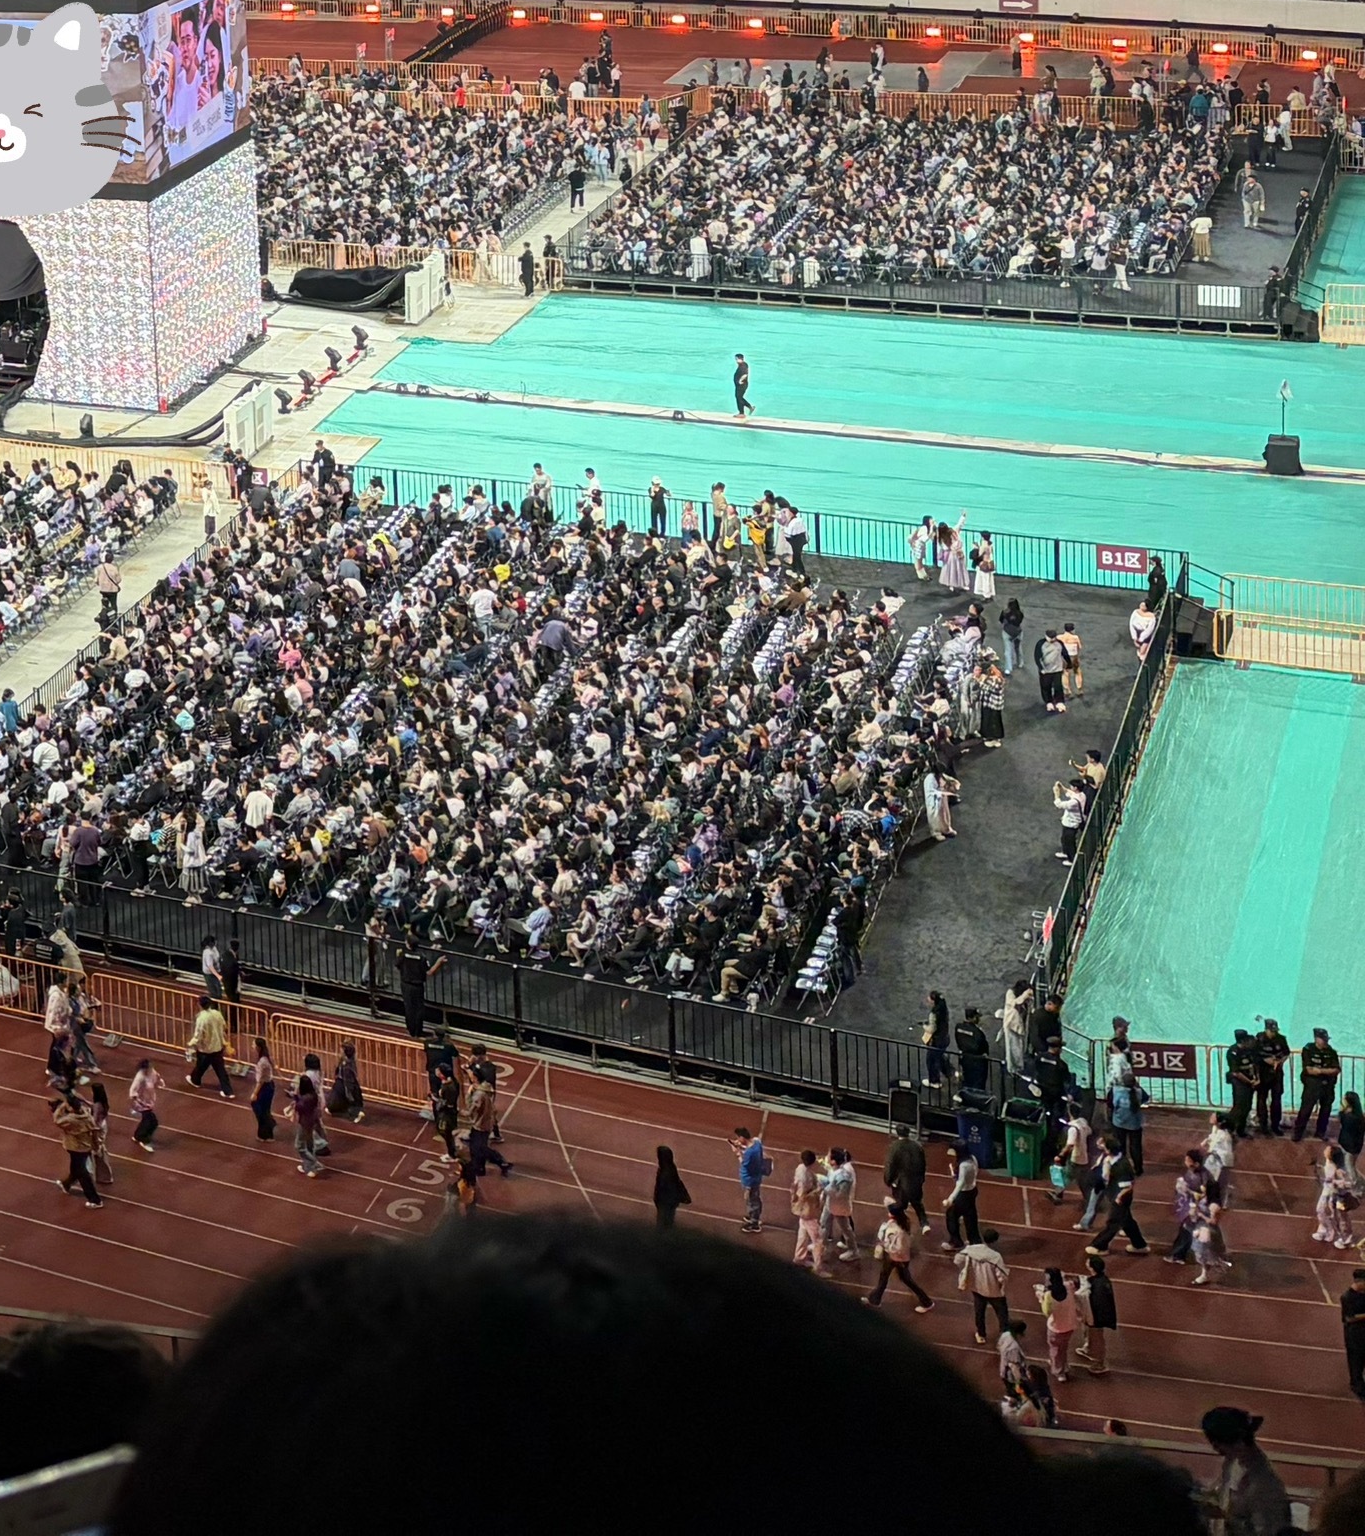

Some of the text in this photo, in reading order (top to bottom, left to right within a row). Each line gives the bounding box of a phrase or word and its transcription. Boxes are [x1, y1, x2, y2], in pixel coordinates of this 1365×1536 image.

[1101, 550, 1142, 569] B1区
[1131, 1050, 1187, 1072] B1区
[409, 1159, 450, 1185] 5
[386, 1197, 426, 1223] 6
